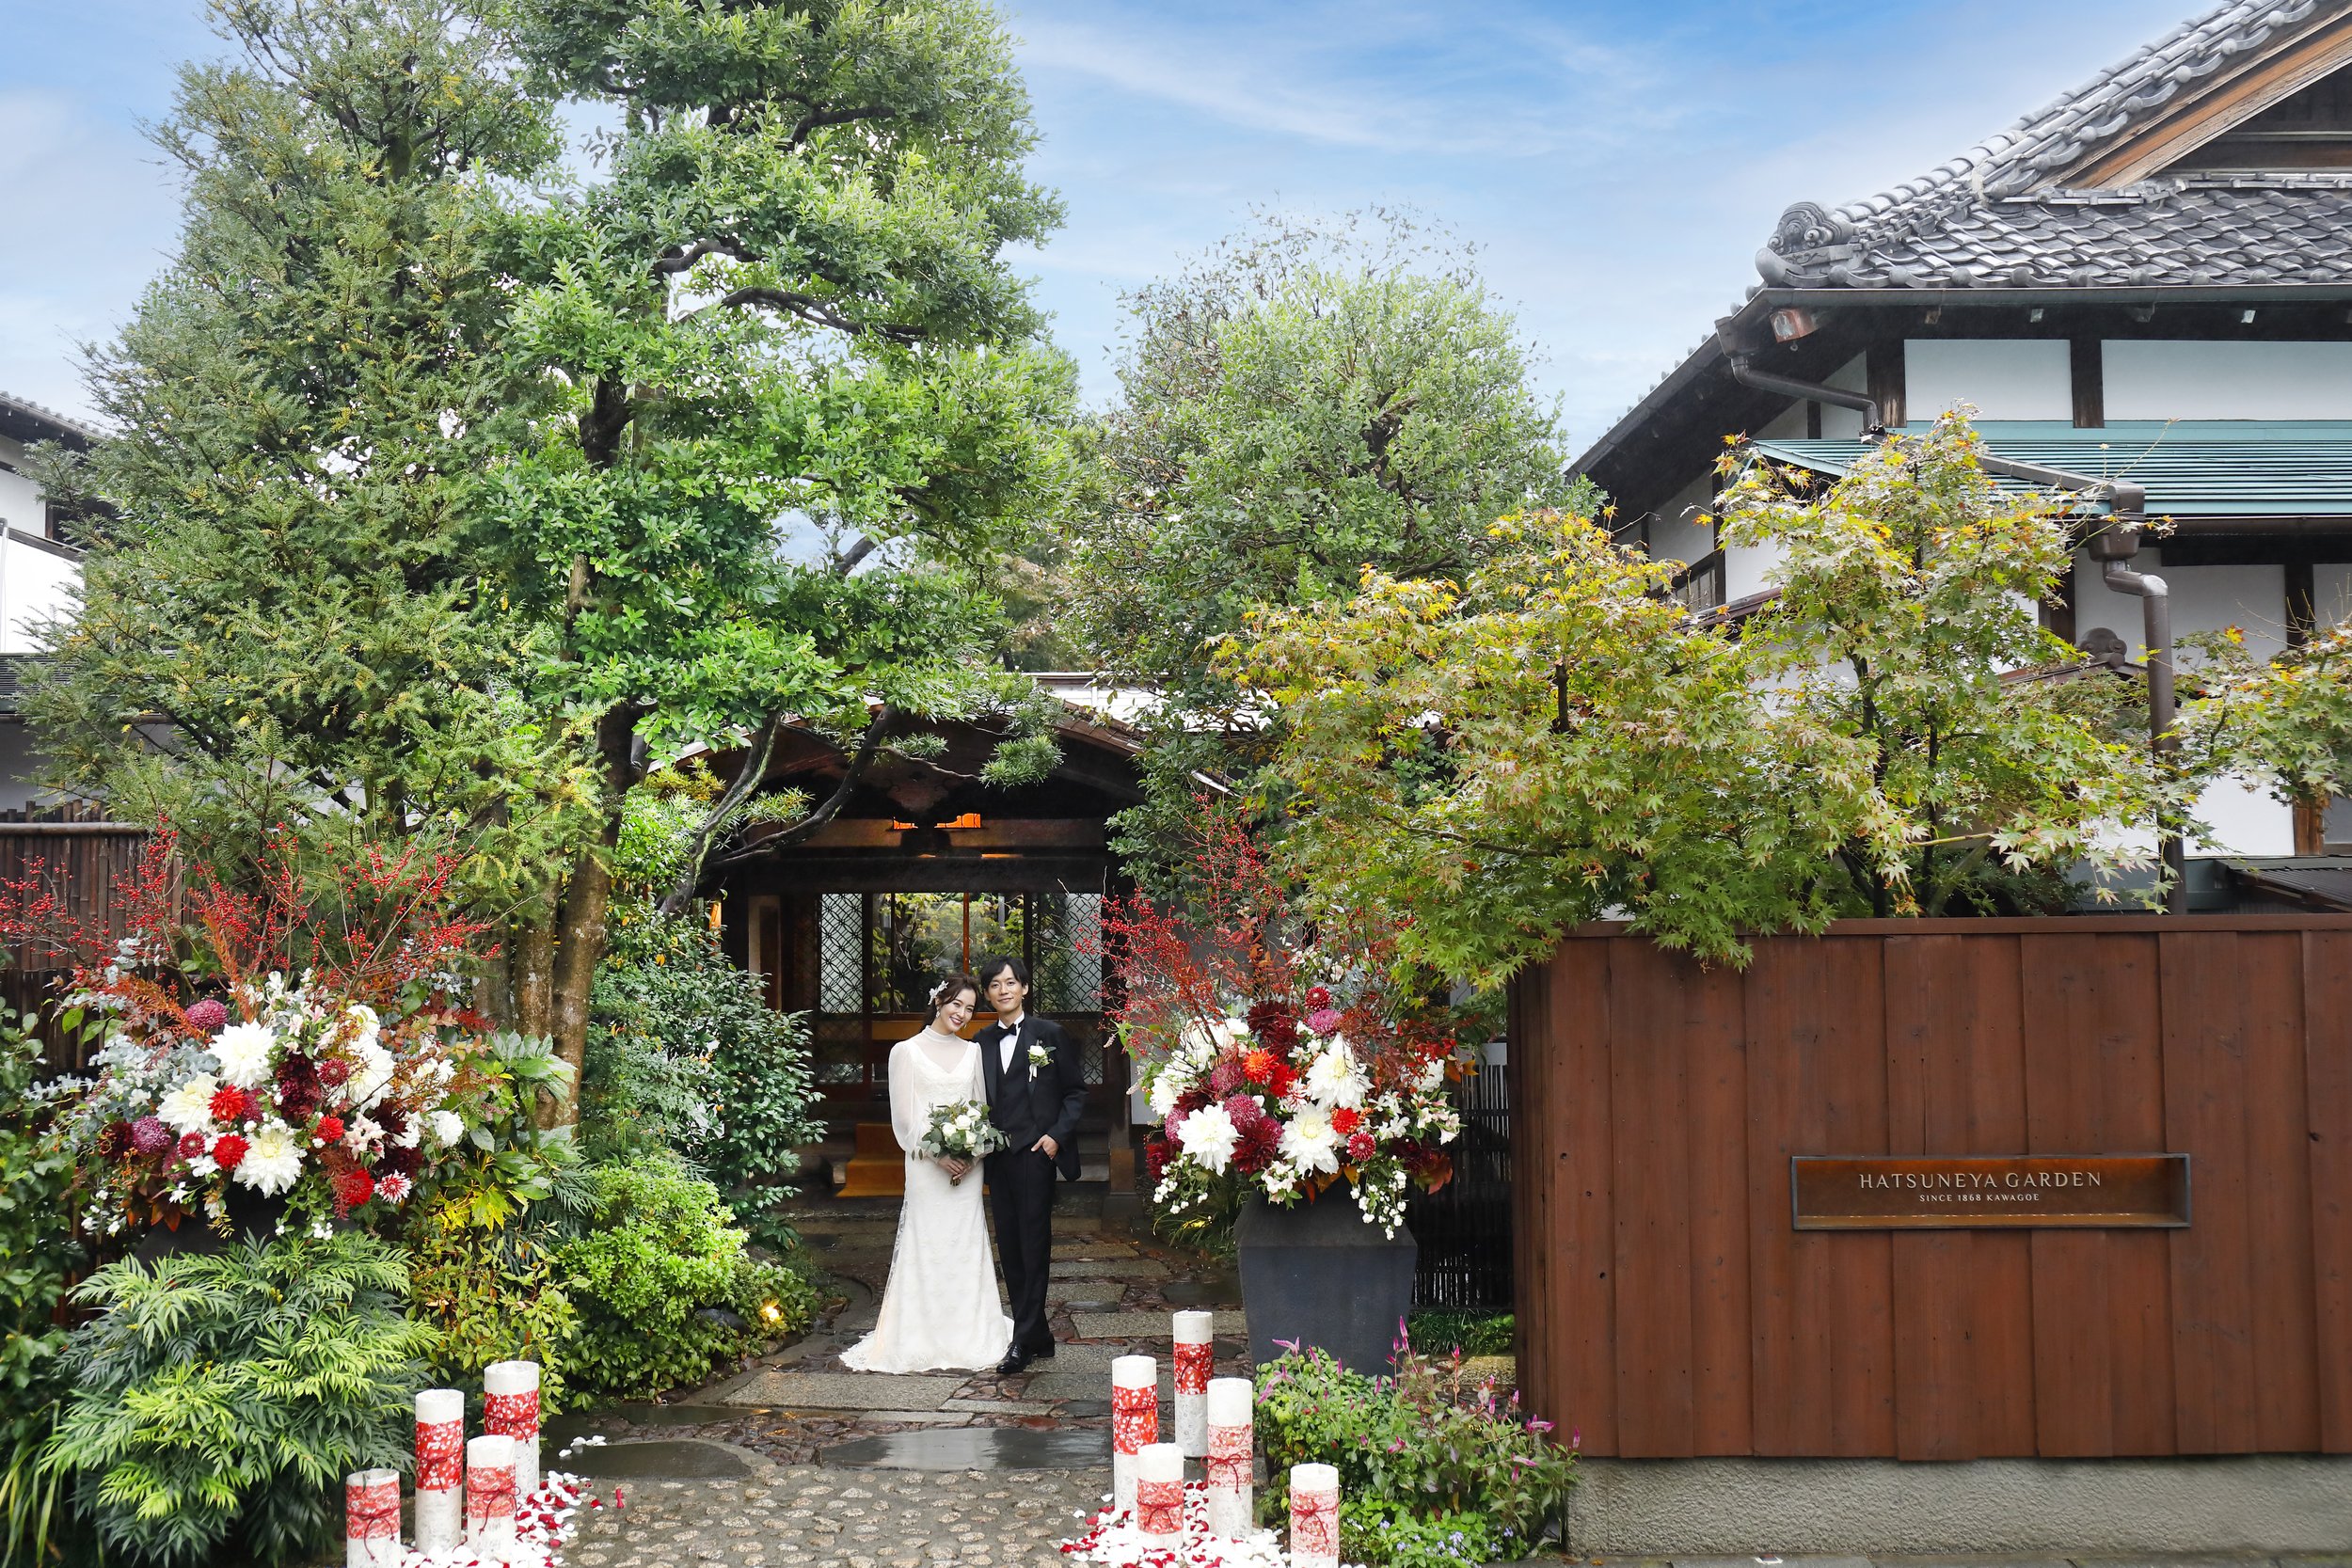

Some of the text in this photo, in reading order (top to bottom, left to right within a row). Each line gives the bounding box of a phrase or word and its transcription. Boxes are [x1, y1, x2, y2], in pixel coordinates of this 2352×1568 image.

[1859, 1172, 2102, 1189] HATSUNEYA GARDEN
[1919, 1193, 2040, 1202] SINCE 1868 KAWAGOE
